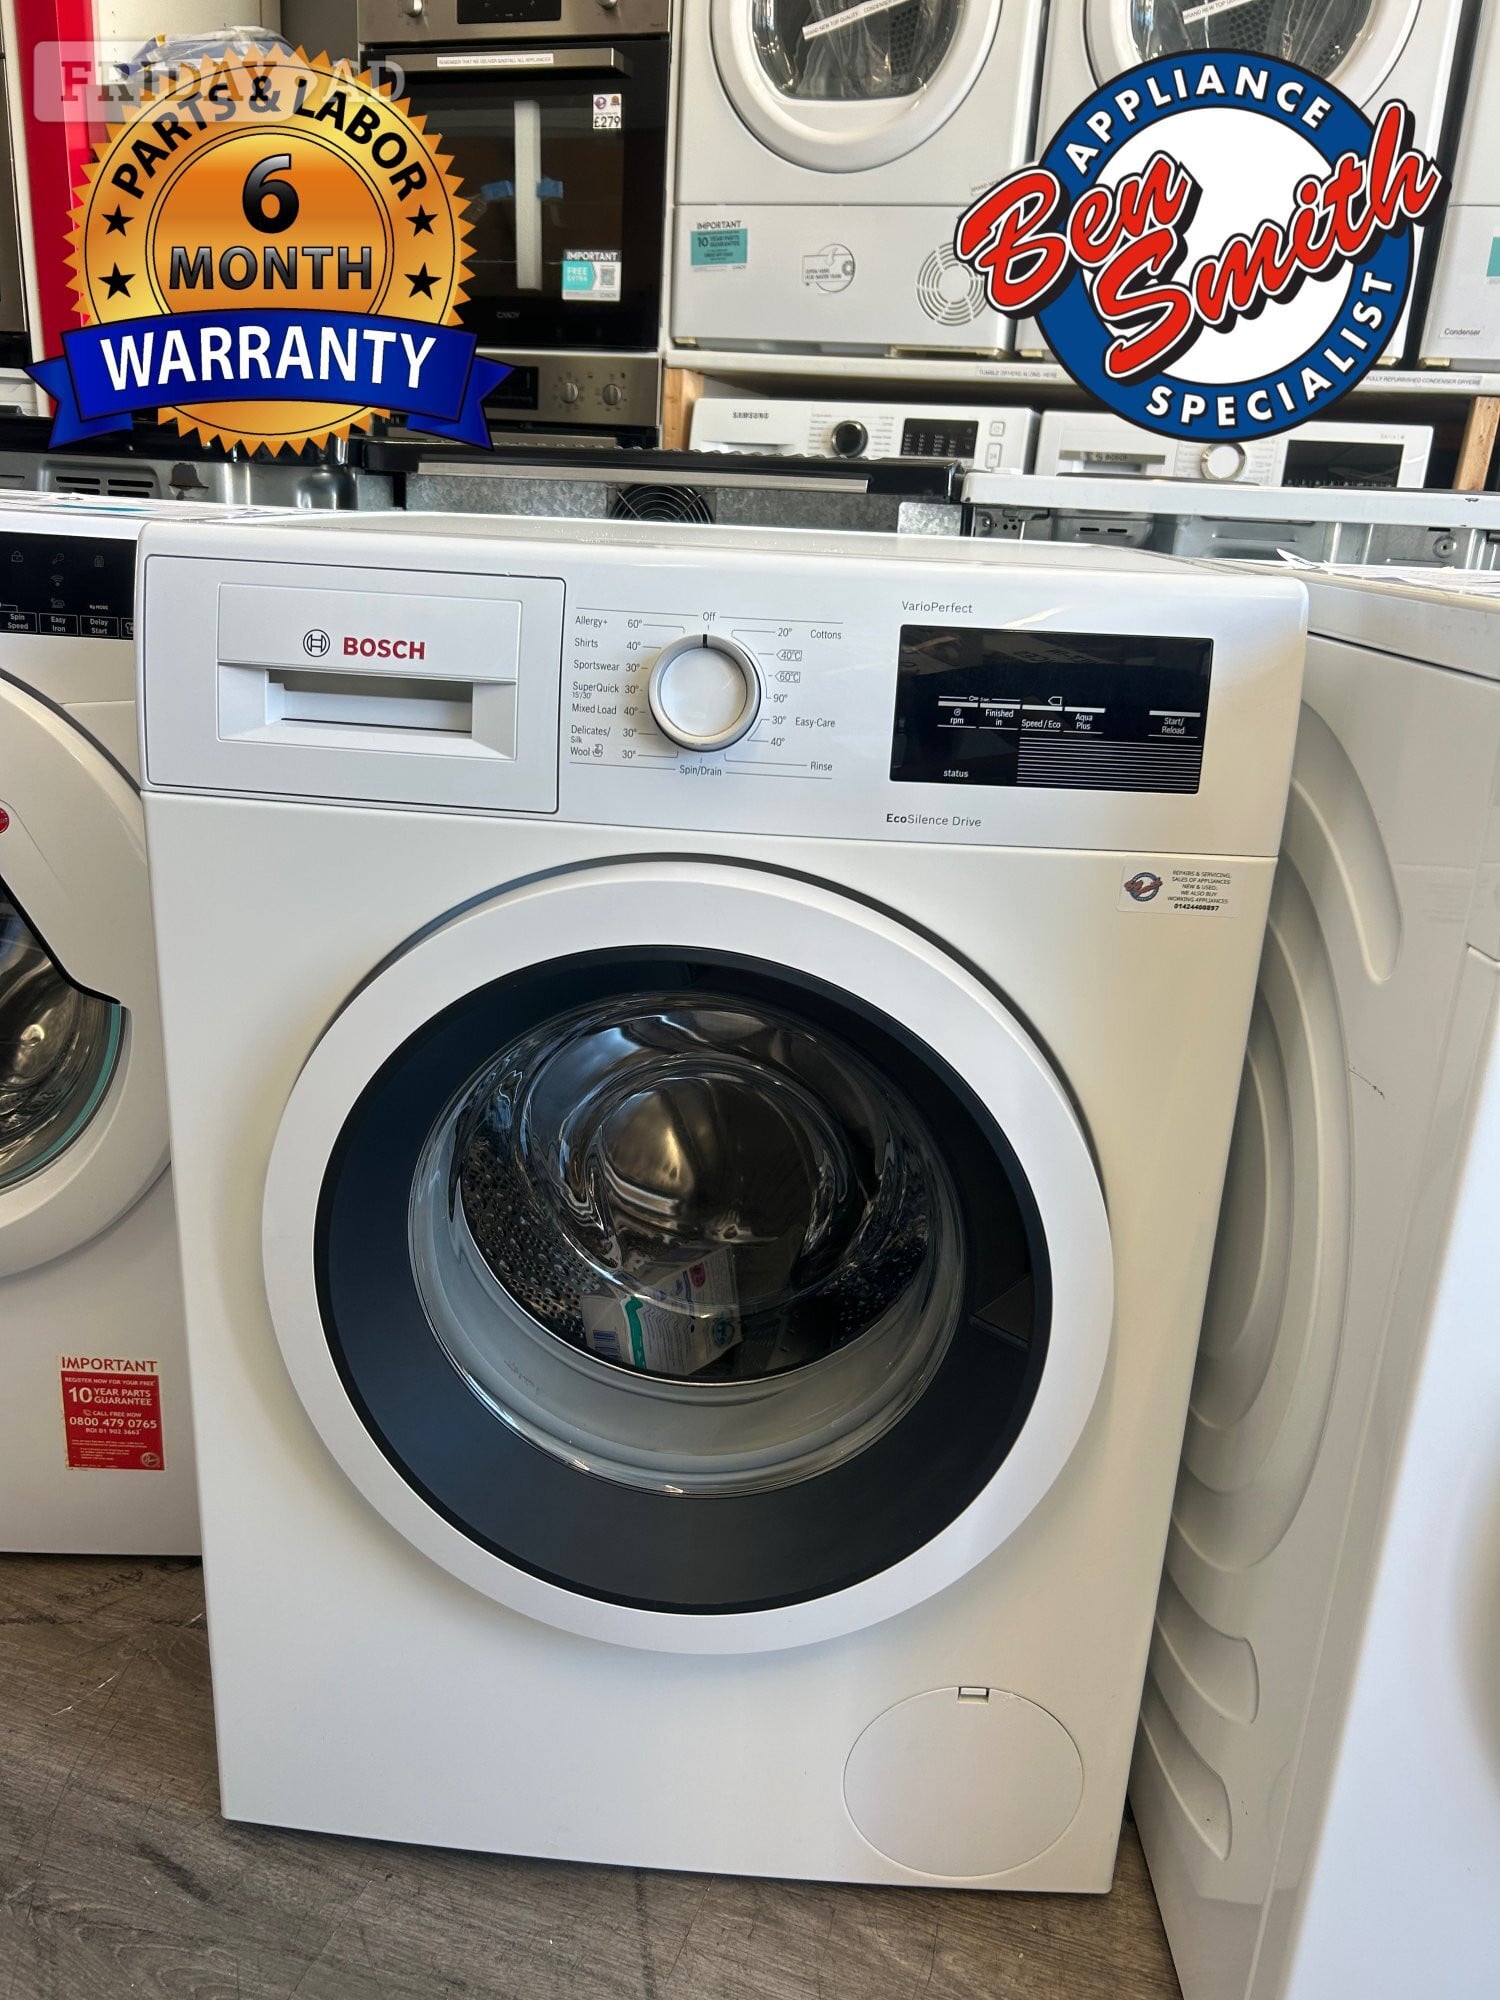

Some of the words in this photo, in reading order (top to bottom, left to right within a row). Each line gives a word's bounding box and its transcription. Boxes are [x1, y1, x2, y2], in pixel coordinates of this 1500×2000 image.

[594, 116, 620, 128] £279
[697, 220, 742, 229] IMPORTANT
[698, 237, 709, 247] 10
[567, 251, 618, 261] IMPORTANT
[1444, 328, 1481, 336] Condenser
[732, 411, 769, 419] SAMSUNG
[902, 600, 973, 613] VarioPerfect
[51, 616, 66, 624] Easy
[575, 615, 608, 627] Allergy+
[703, 611, 716, 621] Off
[8, 622, 28, 630] Speed
[90, 618, 108, 626] Delay
[810, 630, 842, 639] Cottons
[575, 638, 598, 648] Shirts
[344, 637, 425, 660] BOSCH
[574, 660, 620, 671] Sportswear
[573, 681, 619, 693] SuperQuick
[572, 703, 595, 713] Mixed
[598, 705, 617, 715] Load
[985, 708, 1014, 718] Finished
[950, 717, 964, 725] rpm
[1075, 713, 1093, 721] Aqua
[1021, 719, 1043, 728] Speed
[1048, 720, 1061, 728] Eco
[1076, 722, 1091, 730] Plus
[1161, 726, 1185, 735] Reload
[570, 746, 590, 756] Wool
[680, 764, 722, 776] Spin/Drain
[810, 761, 833, 771] Rinse
[943, 769, 969, 778] status
[886, 813, 949, 826] EcoSilence
[952, 816, 982, 827] Drive
[62, 1356, 157, 1372] IMPORTANT
[69, 1386, 93, 1403] 10
[94, 1388, 119, 1396] YEAR
[122, 1389, 151, 1397] PARTS
[94, 1396, 152, 1406] GUARANTEE
[69, 1417, 99, 1426] 0800
[103, 1418, 124, 1427] 479
[128, 1419, 157, 1429] 0765
